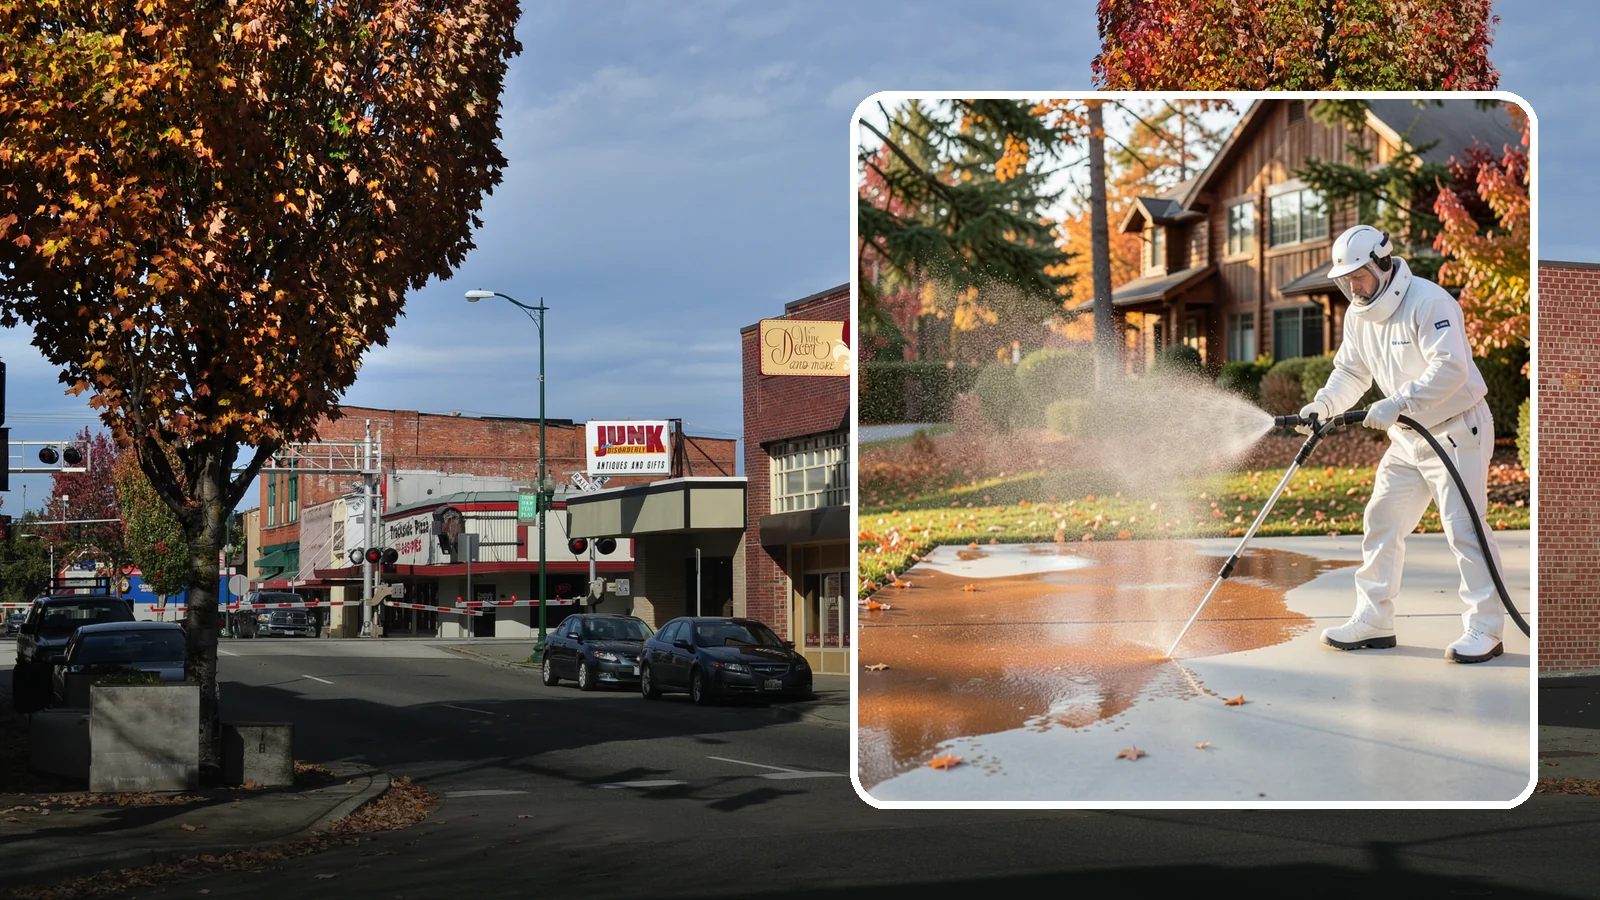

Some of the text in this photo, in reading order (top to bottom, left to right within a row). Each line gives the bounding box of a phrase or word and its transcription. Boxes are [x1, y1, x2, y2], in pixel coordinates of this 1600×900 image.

[596, 425, 665, 457] JUNK
[607, 446, 646, 454] DISORDERLY
[597, 460, 665, 470] ANTIQUES AND GIFTS
[573, 473, 589, 492] RAIL
[390, 519, 429, 539] Trackside Pizza
